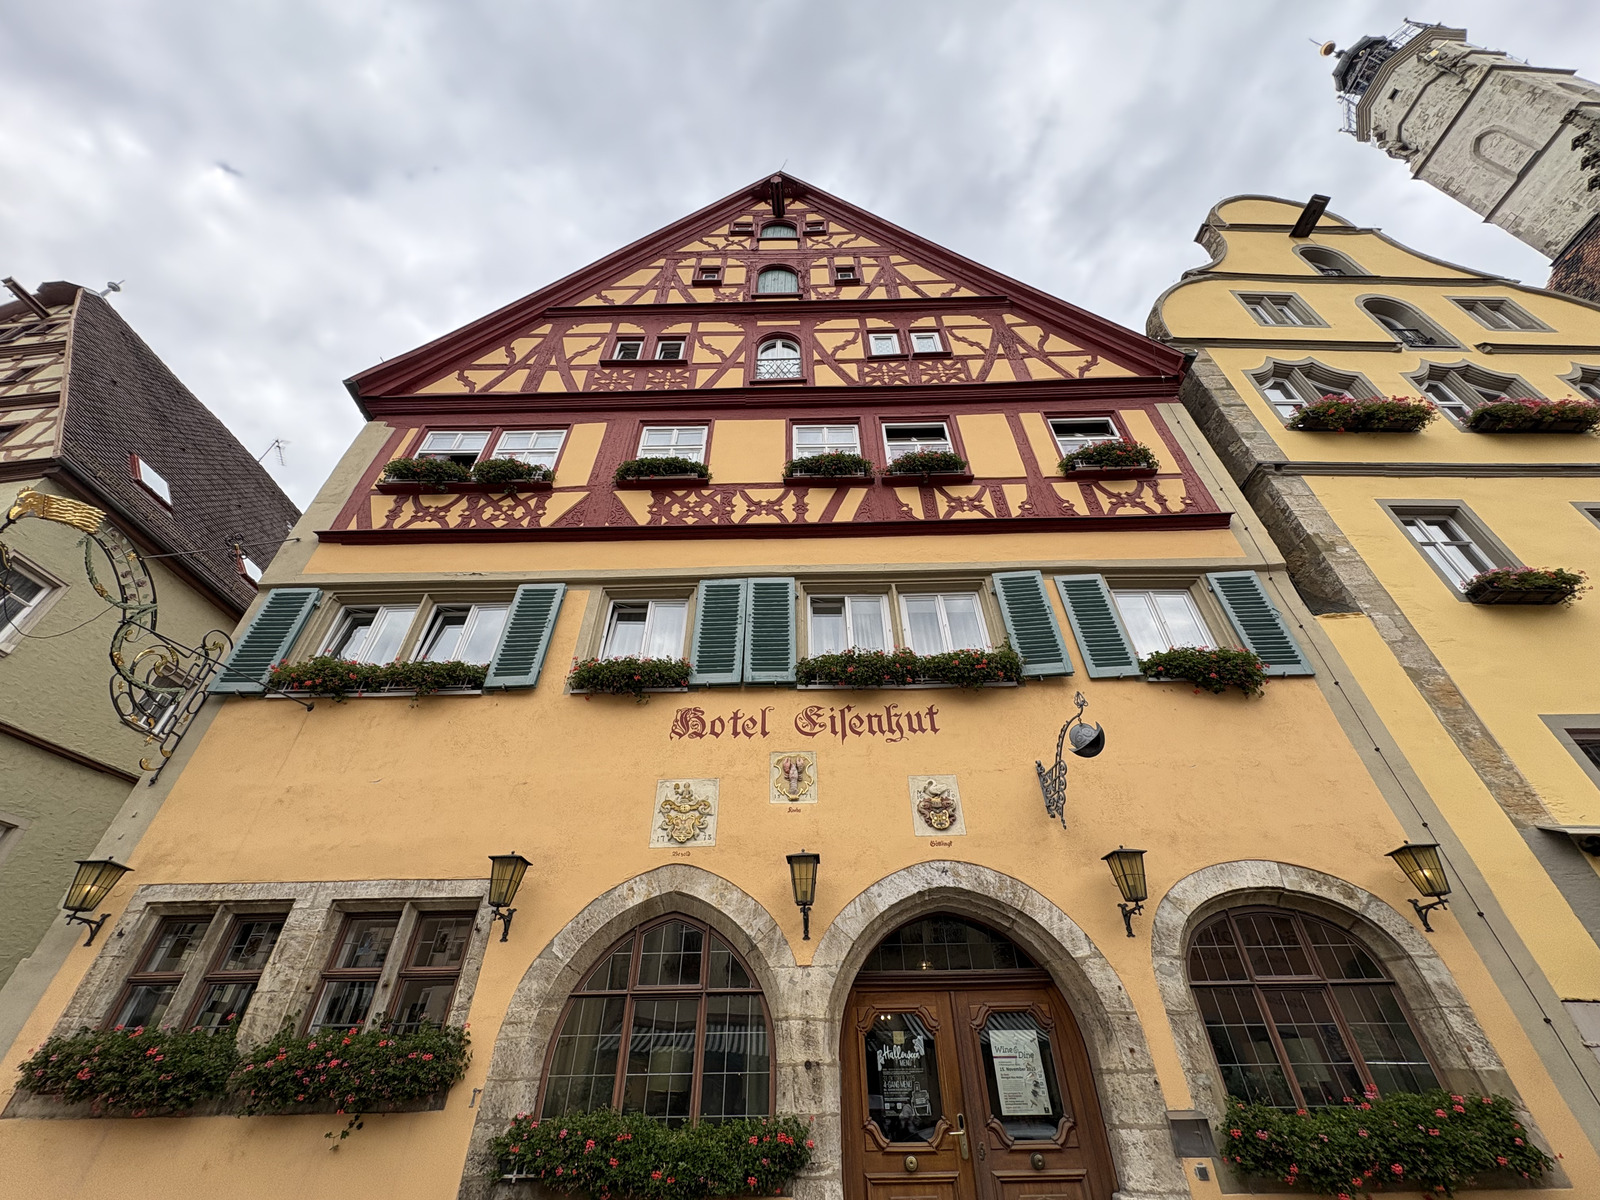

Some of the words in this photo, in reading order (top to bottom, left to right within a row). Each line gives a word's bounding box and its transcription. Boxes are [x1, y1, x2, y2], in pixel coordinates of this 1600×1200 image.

[669, 706, 775, 741] Hotel
[883, 1044, 920, 1060] Halloween
[994, 1045, 1013, 1054] Wine
[1018, 1051, 1035, 1059] Dine
